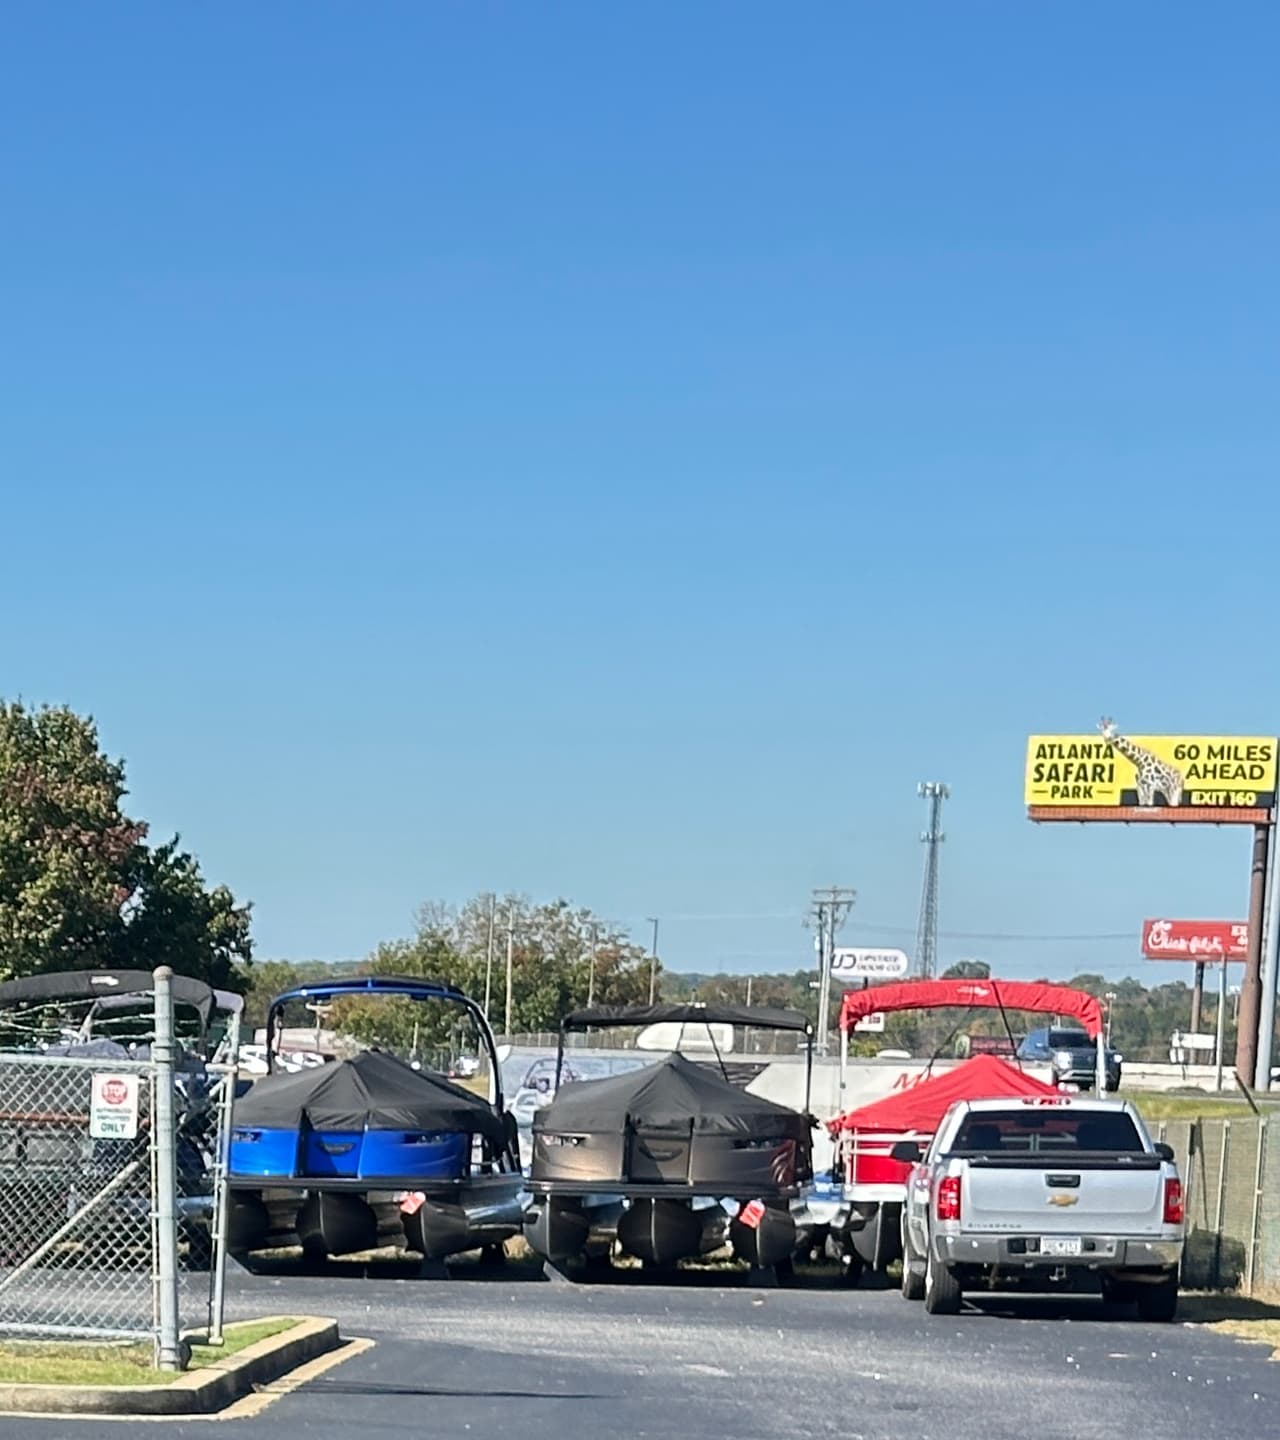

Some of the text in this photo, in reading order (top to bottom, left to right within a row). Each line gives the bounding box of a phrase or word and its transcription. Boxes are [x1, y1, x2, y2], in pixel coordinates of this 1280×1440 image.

[1035, 743, 1115, 760] ATLANTA
[1173, 744, 1272, 762] 60 MILES
[1033, 762, 1115, 783] SAFARI
[1185, 763, 1266, 781] AHEAD
[1050, 785, 1094, 799] PARK
[1190, 790, 1257, 807] EXIT 160
[101, 1122, 126, 1133] ONLY
